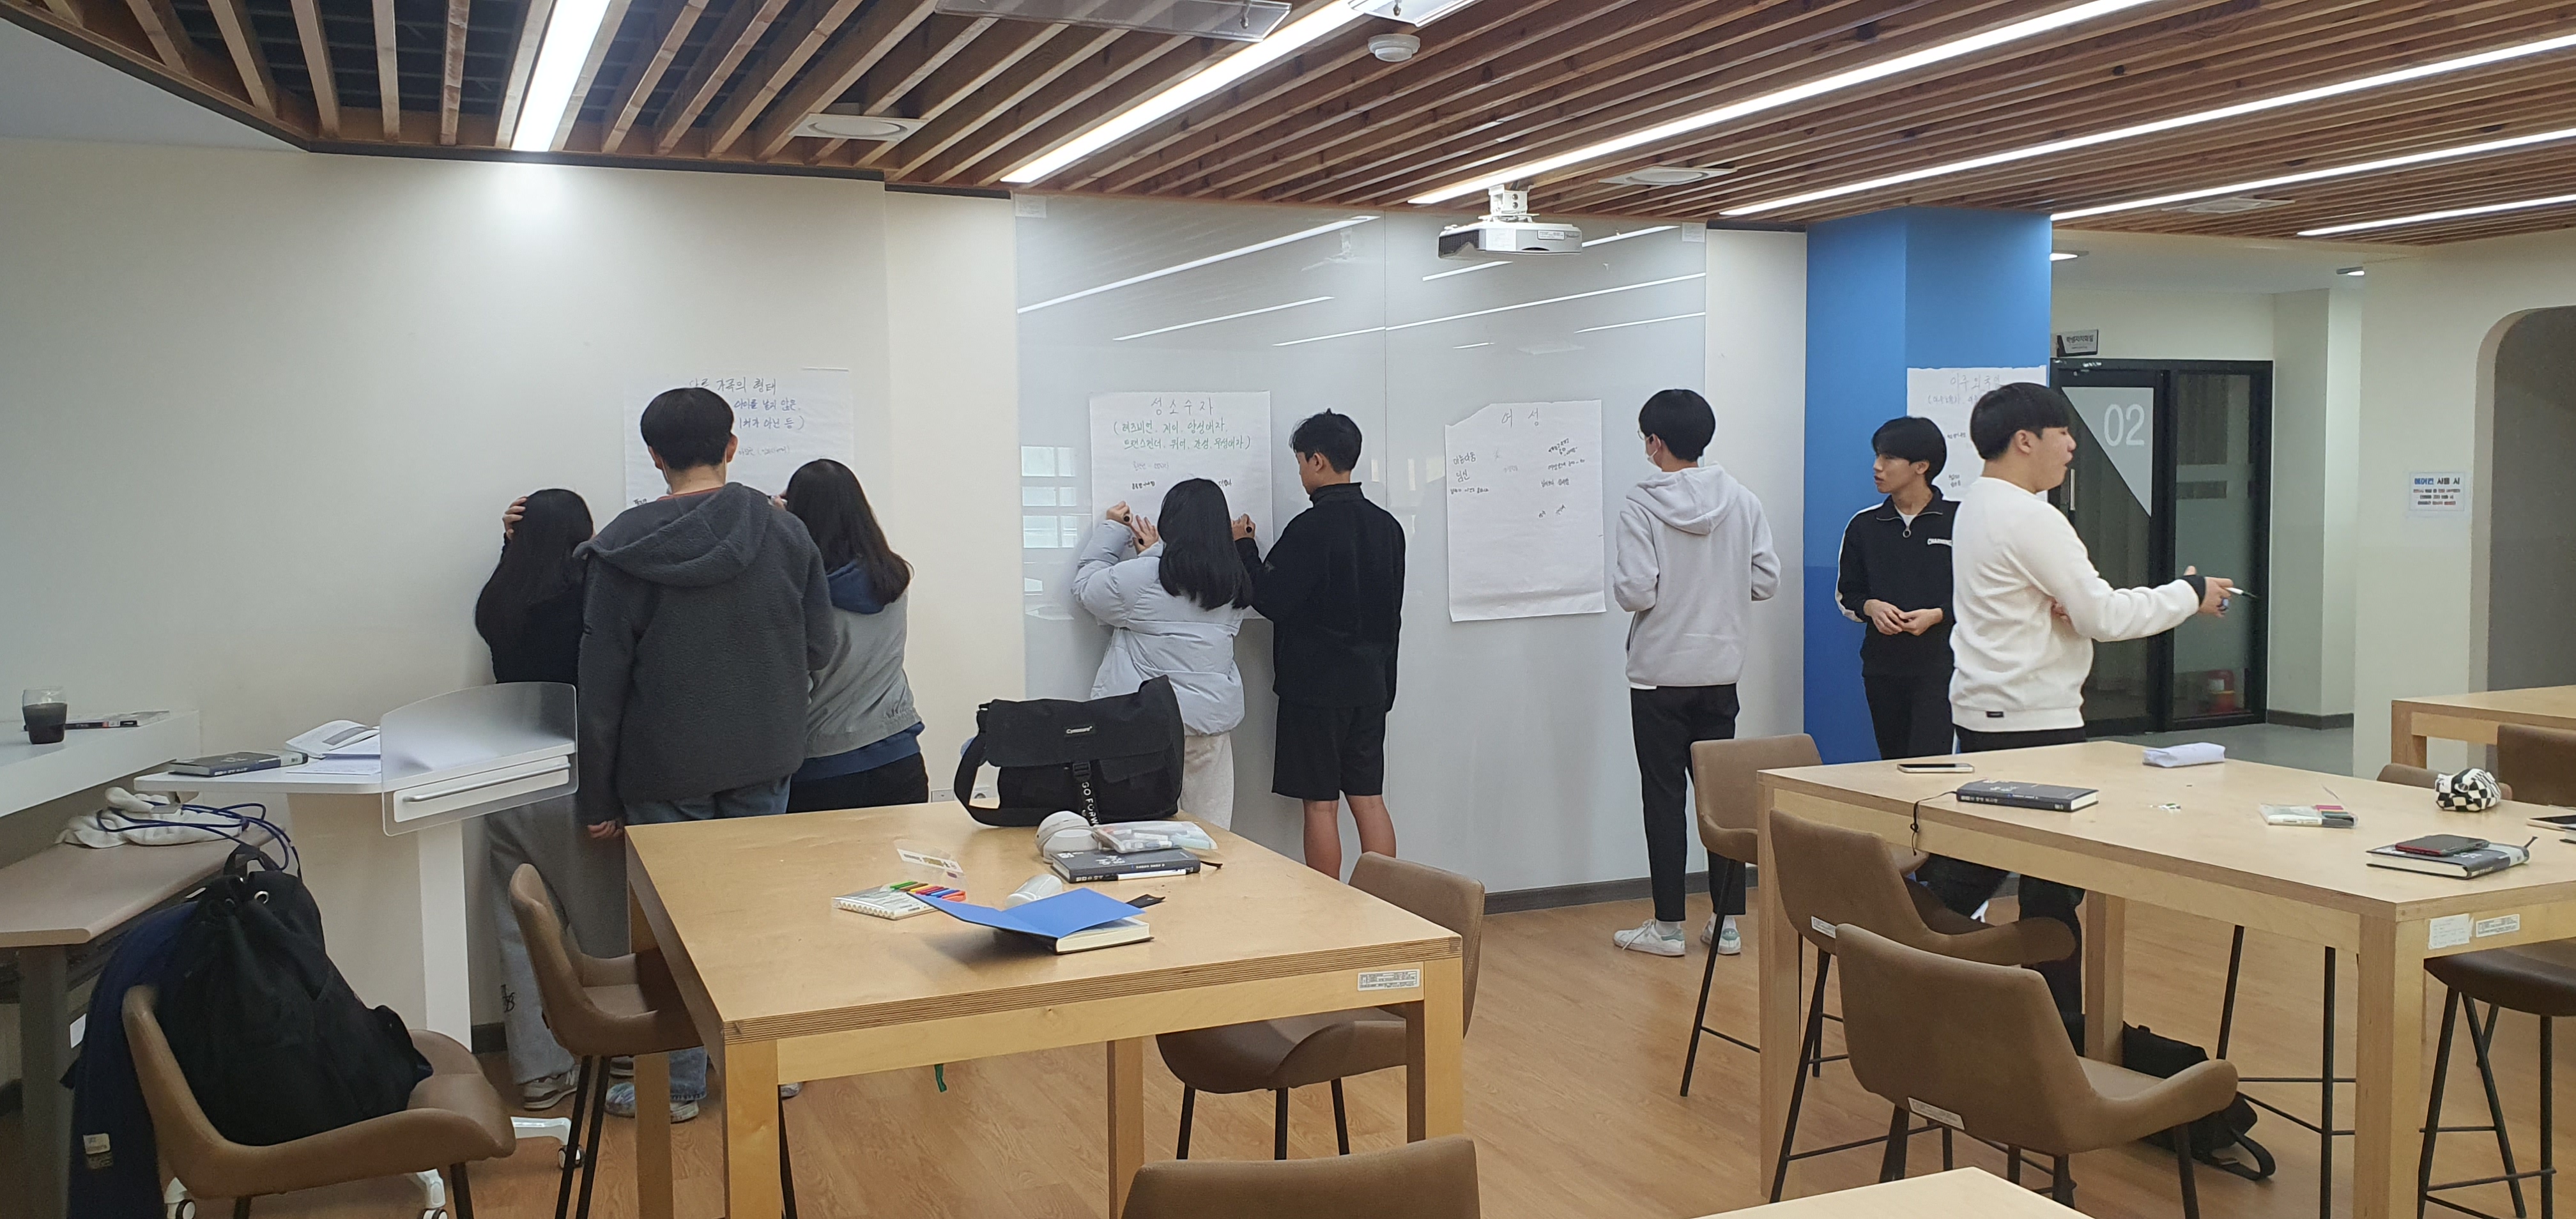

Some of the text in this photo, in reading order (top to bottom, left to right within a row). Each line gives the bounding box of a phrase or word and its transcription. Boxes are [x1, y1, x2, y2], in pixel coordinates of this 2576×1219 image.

[716, 376, 746, 393] 가족의
[753, 378, 776, 395] 형태
[733, 398, 758, 410] 아이를
[762, 399, 776, 411] 낳지
[763, 416, 780, 429] 아닌
[2104, 403, 2145, 447] 02
[2453, 477, 2460, 485] 시
[1082, 781, 1091, 796] GO
